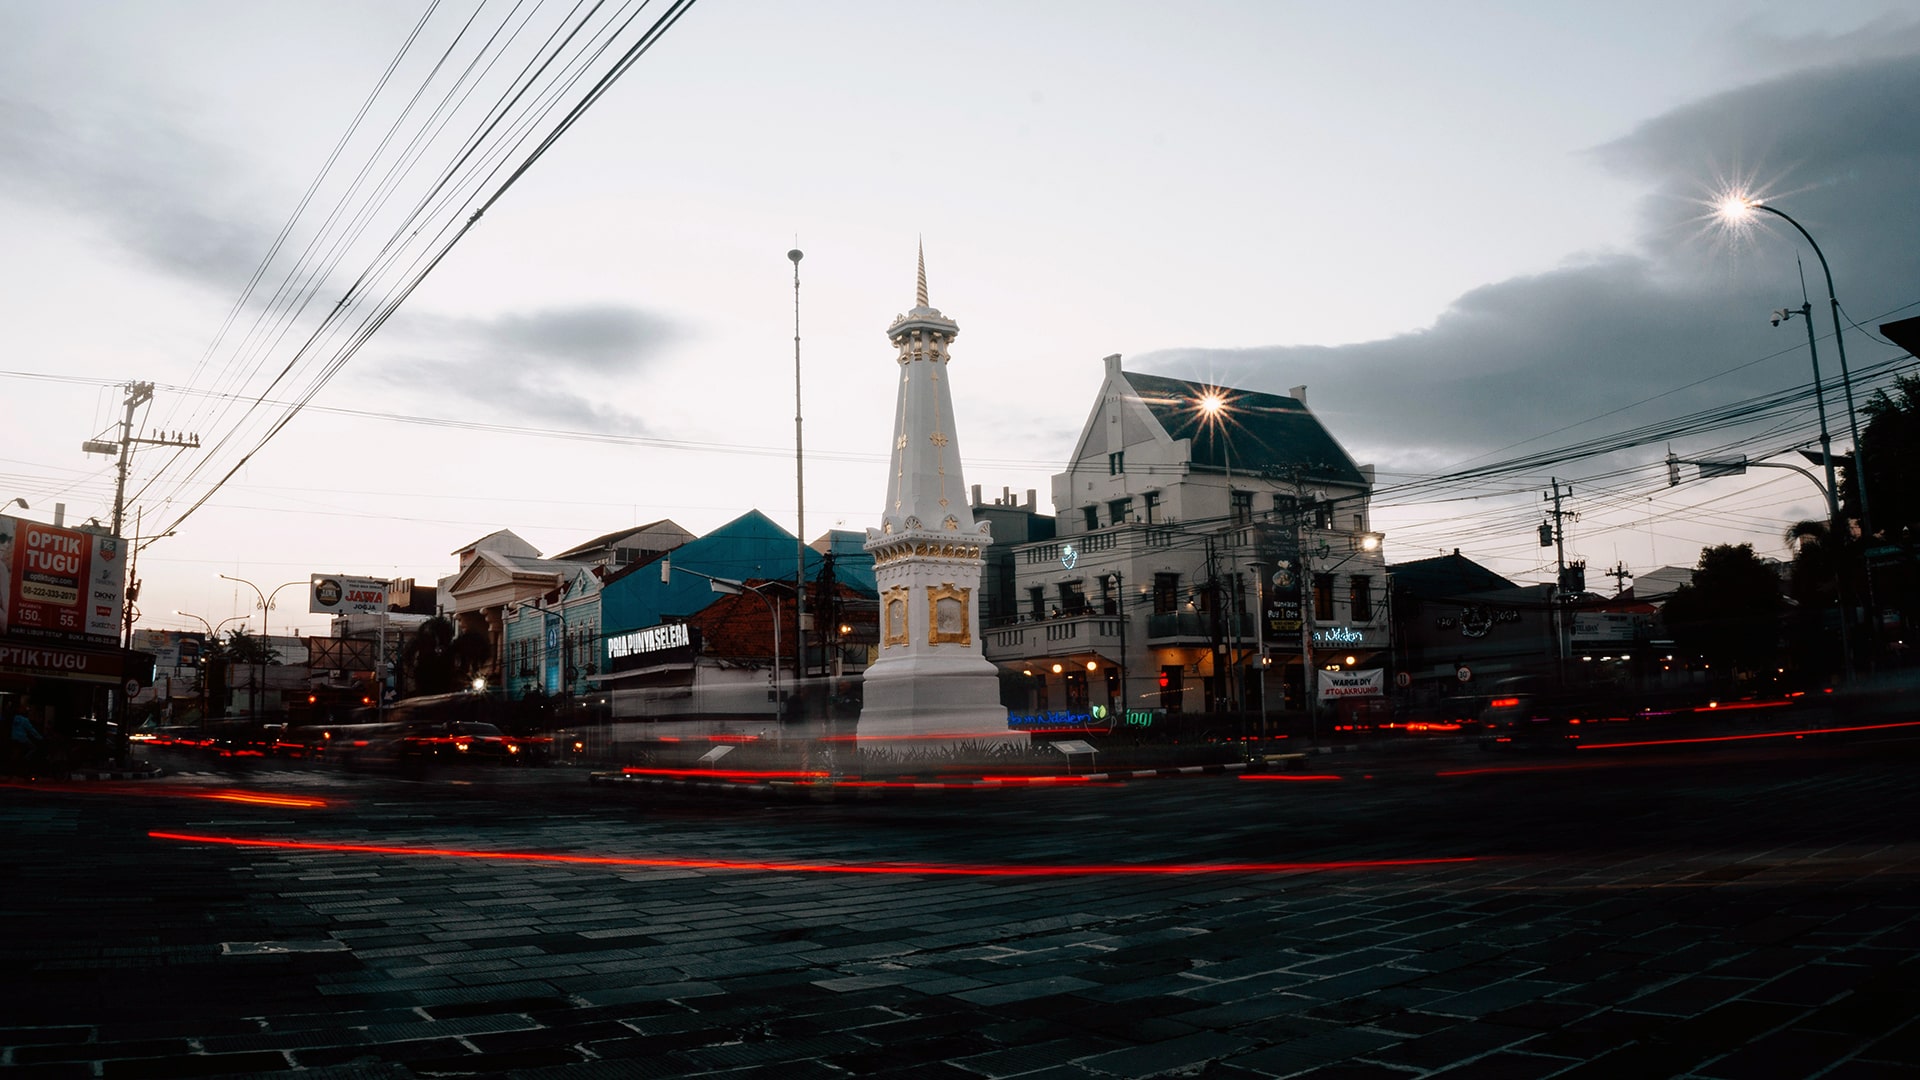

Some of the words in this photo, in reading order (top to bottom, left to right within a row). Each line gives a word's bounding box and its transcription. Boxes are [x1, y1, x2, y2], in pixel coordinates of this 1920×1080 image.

[28, 531, 80, 555] OPTIK
[27, 550, 79, 574] TUGU
[94, 591, 116, 601] DKNY
[345, 590, 383, 603] JAWA
[42, 651, 87, 670] TUGU
[1331, 679, 1358, 687] WARGA
[1359, 678, 1372, 686] DIY
